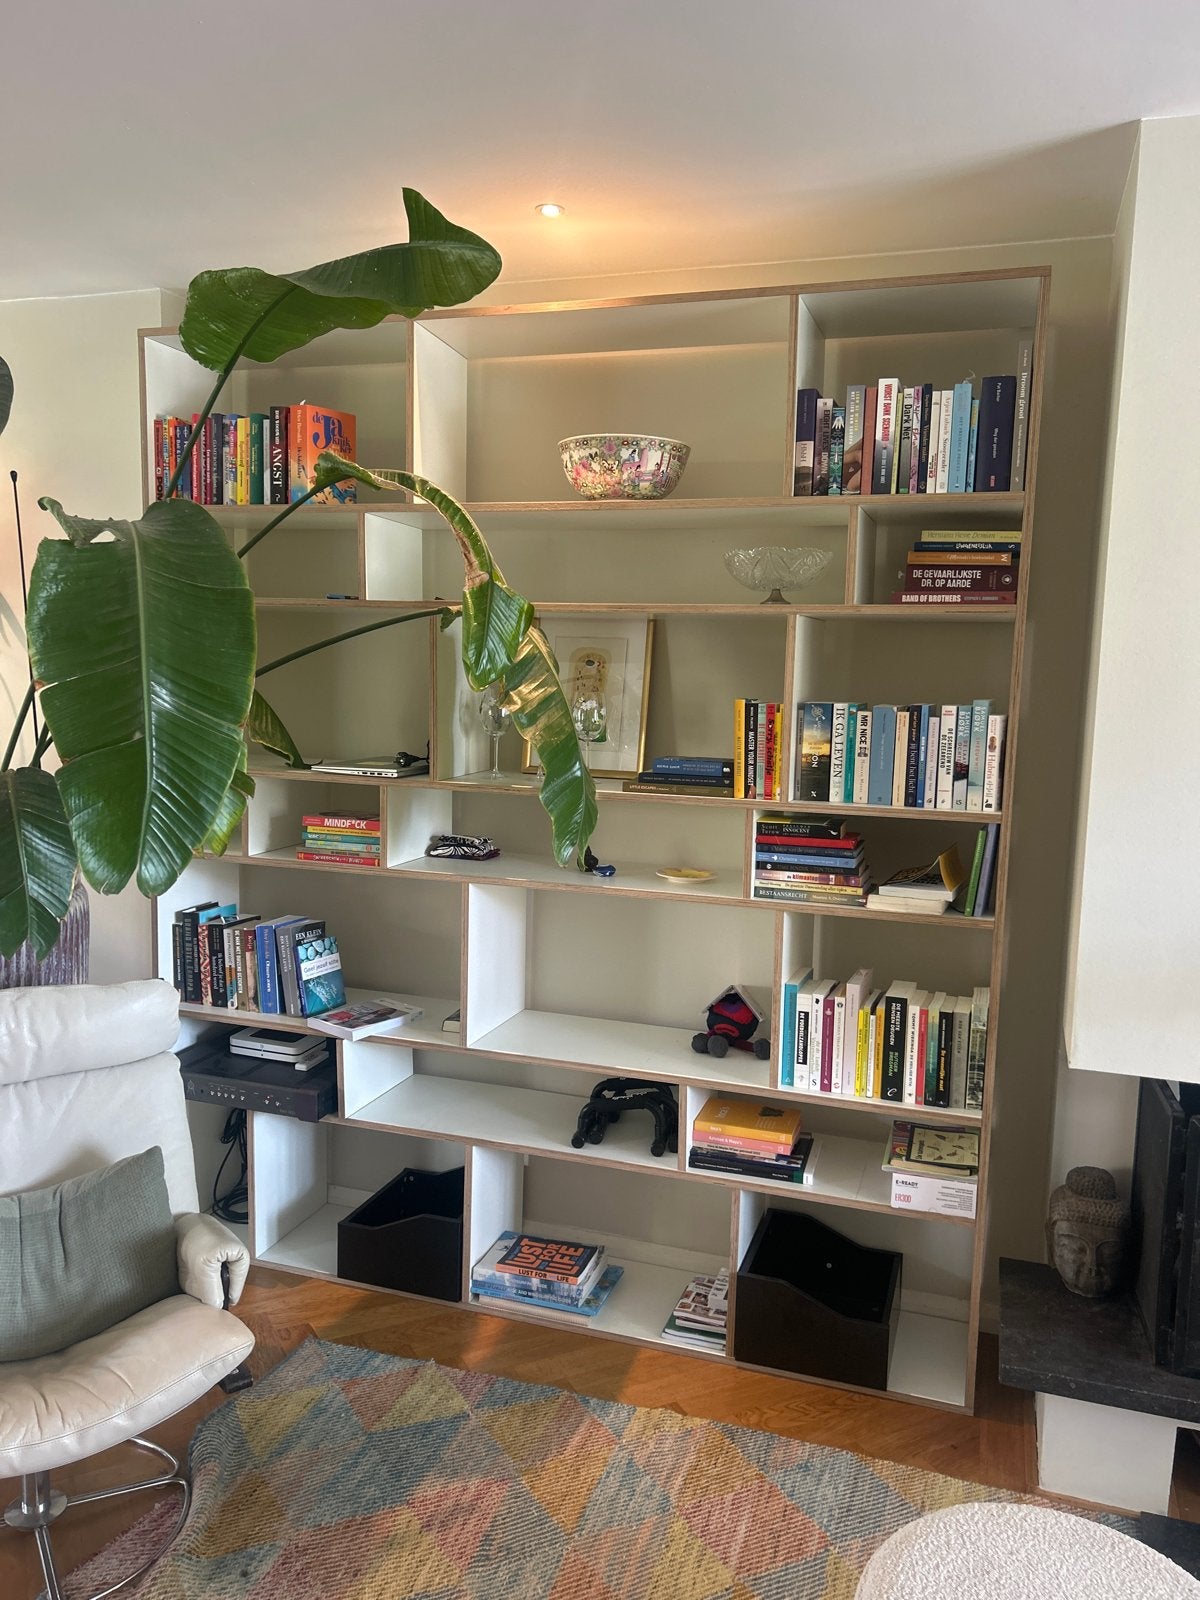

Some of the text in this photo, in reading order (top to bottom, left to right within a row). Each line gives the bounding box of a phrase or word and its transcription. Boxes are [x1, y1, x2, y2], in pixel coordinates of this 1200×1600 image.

[884, 384, 892, 401] WORST
[883, 403, 892, 416] BANK
[881, 418, 891, 441] SCENARIO
[903, 404, 912, 440] Dark Net
[940, 438, 948, 472] Stoorzender
[272, 446, 282, 487] ANGST
[921, 579, 934, 587] DR.
[947, 580, 971, 588] AARDE
[924, 570, 981, 579] GEVAARLIJKSTE
[861, 715, 868, 726] MR
[833, 708, 845, 778] IK GA LEVEN
[986, 754, 996, 779] Hubris
[759, 890, 807, 898] BESTAANSRECHT
[895, 1194, 911, 1203] ER300
[505, 1238, 546, 1268] LUST
[539, 1243, 562, 1260] FOR
[545, 1245, 584, 1274] LIFE
